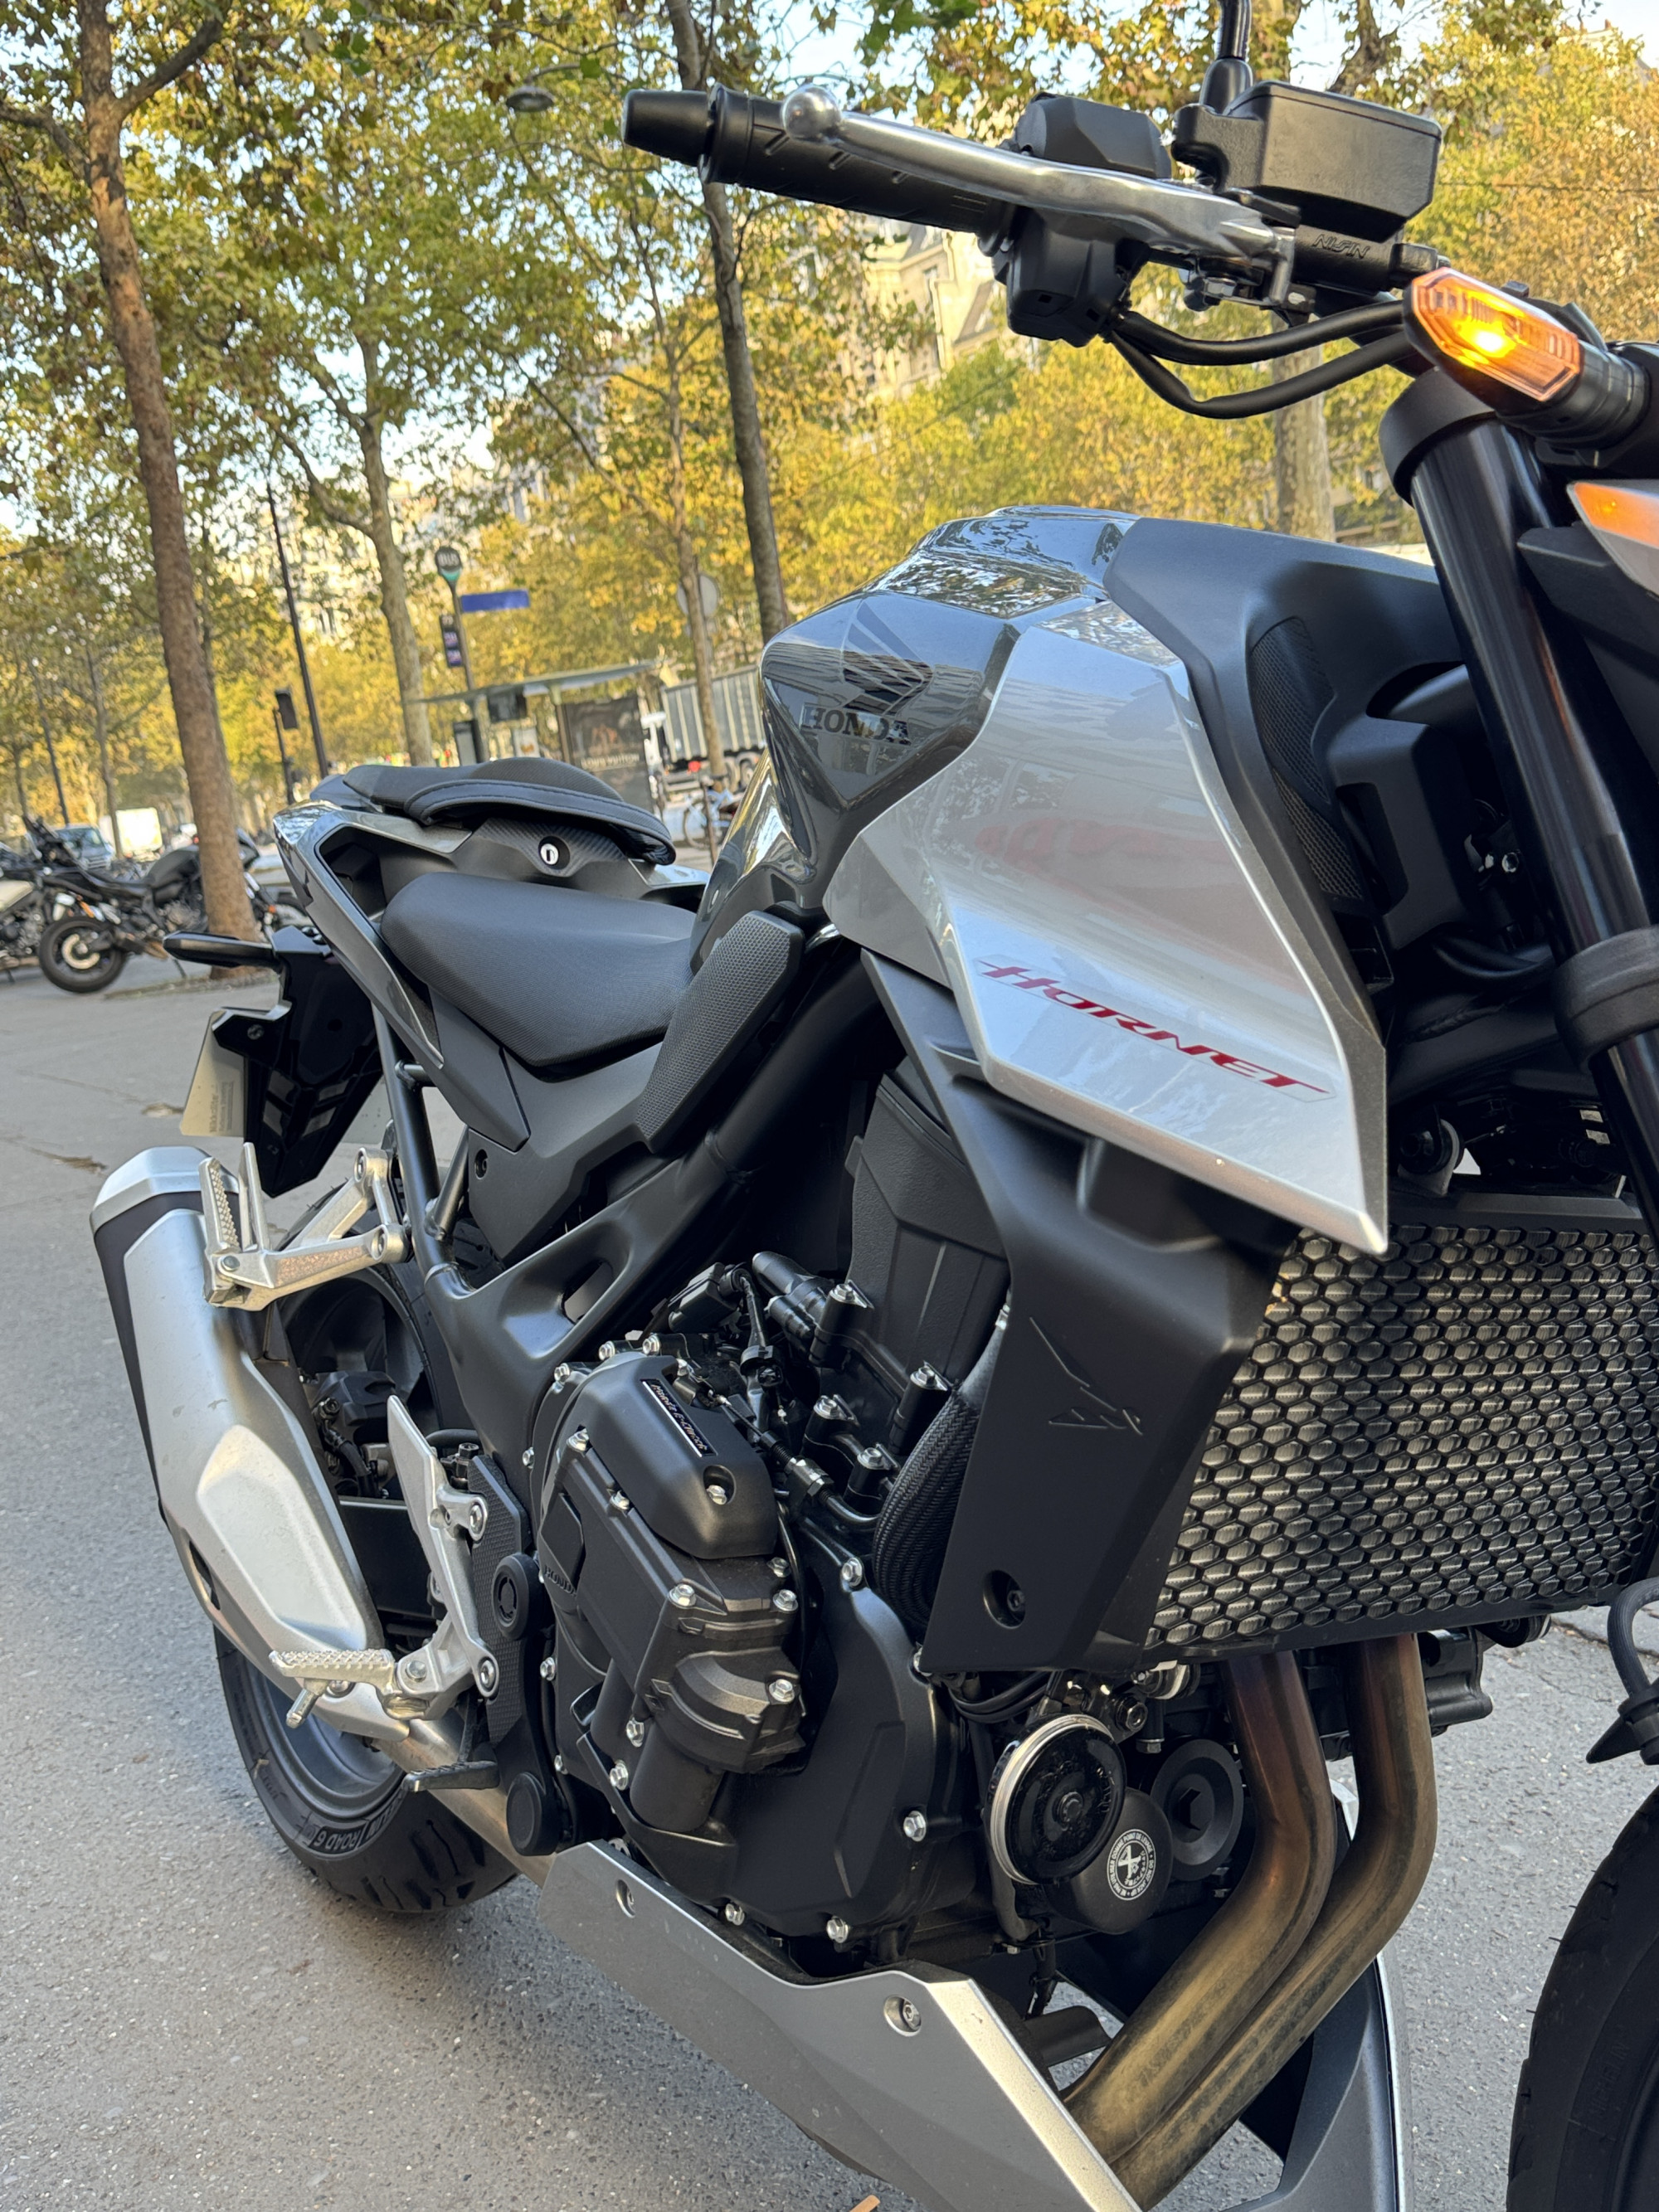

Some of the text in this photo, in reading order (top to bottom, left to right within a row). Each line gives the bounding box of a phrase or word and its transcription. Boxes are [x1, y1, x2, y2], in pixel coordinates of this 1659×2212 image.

[800, 703, 912, 746] HONDA
[979, 960, 1330, 1093] HORNET
[314, 1830, 327, 1847] 6
[324, 1830, 361, 1851] ROAD
